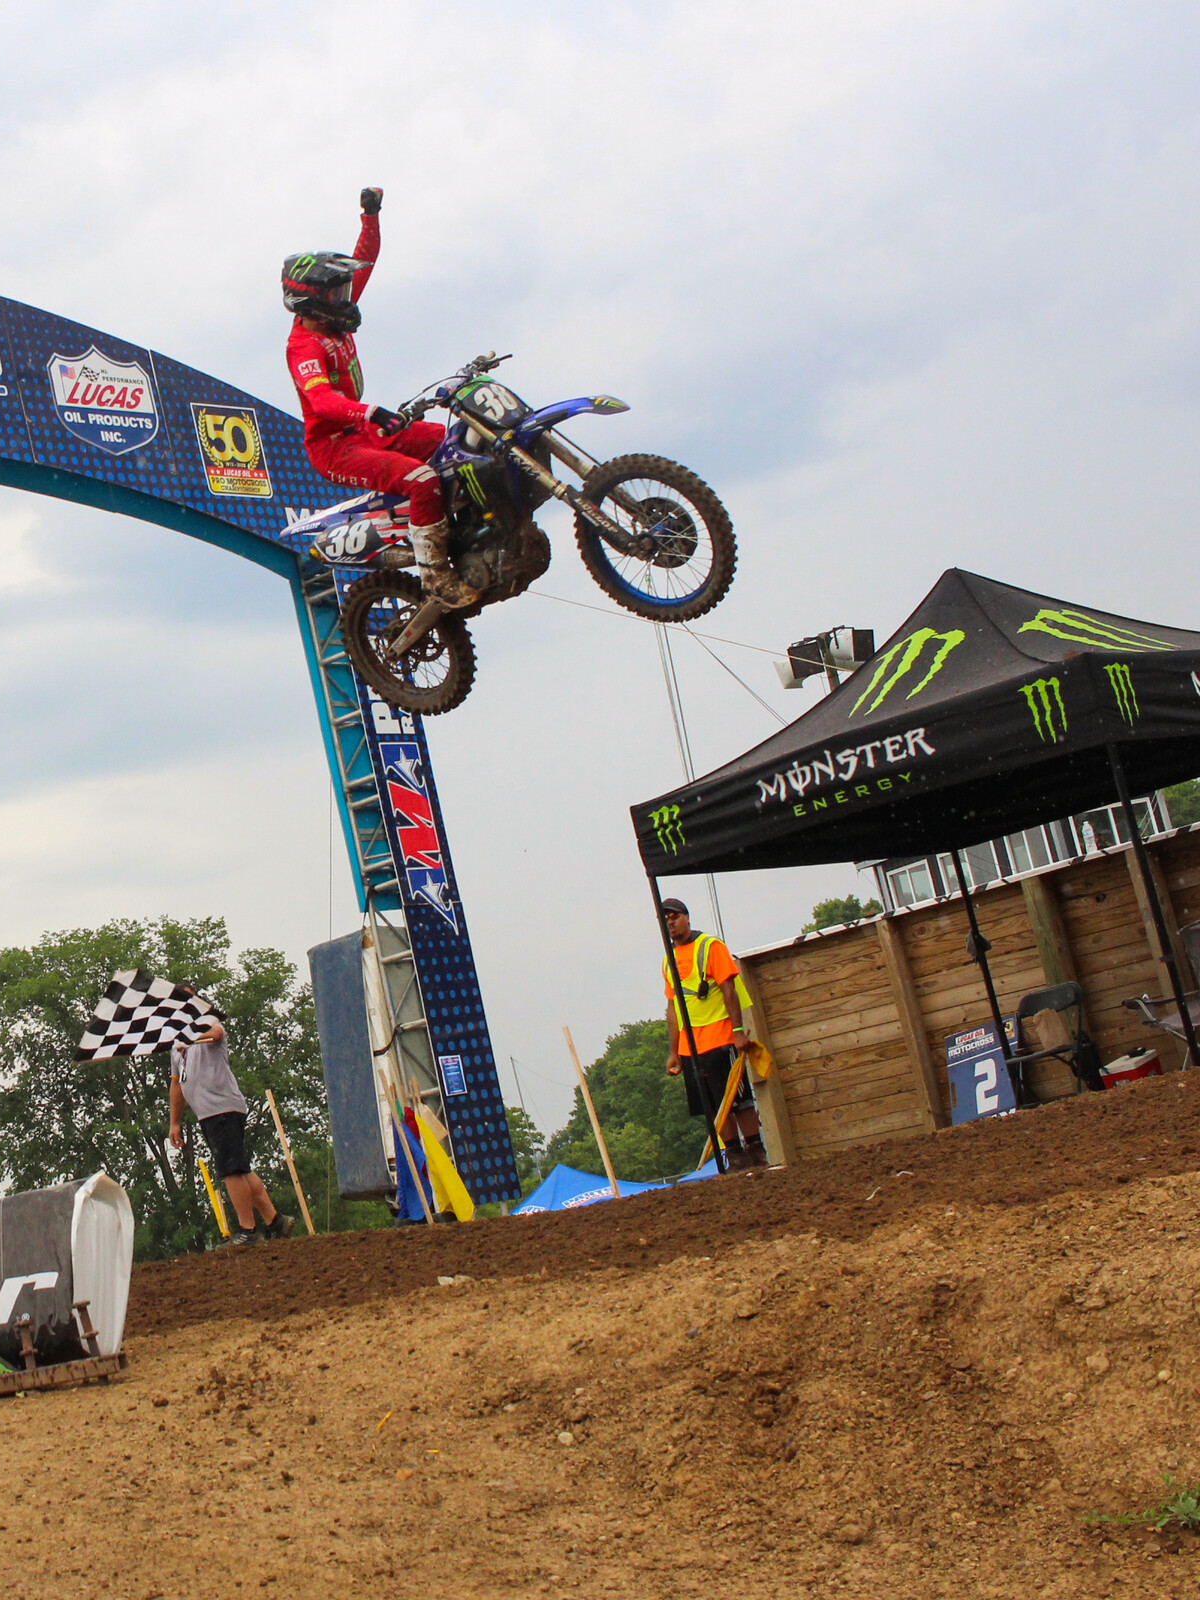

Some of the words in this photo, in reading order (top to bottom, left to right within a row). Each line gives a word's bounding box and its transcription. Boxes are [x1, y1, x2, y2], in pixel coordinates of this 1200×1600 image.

[66, 381, 145, 409] LUCAS
[102, 376, 144, 386] PERFORMANCE
[64, 411, 86, 424] OIL
[87, 413, 153, 430] PRODUCTS
[473, 382, 518, 421] 38
[204, 413, 255, 463] 50
[223, 468, 241, 477] LUCAS
[241, 469, 252, 477] OIL
[325, 518, 371, 558] 38
[756, 727, 936, 803] MONSTER
[793, 771, 912, 817] ENERGY
[948, 1035, 995, 1057] MOTOCROSS
[974, 1058, 999, 1115] 2
